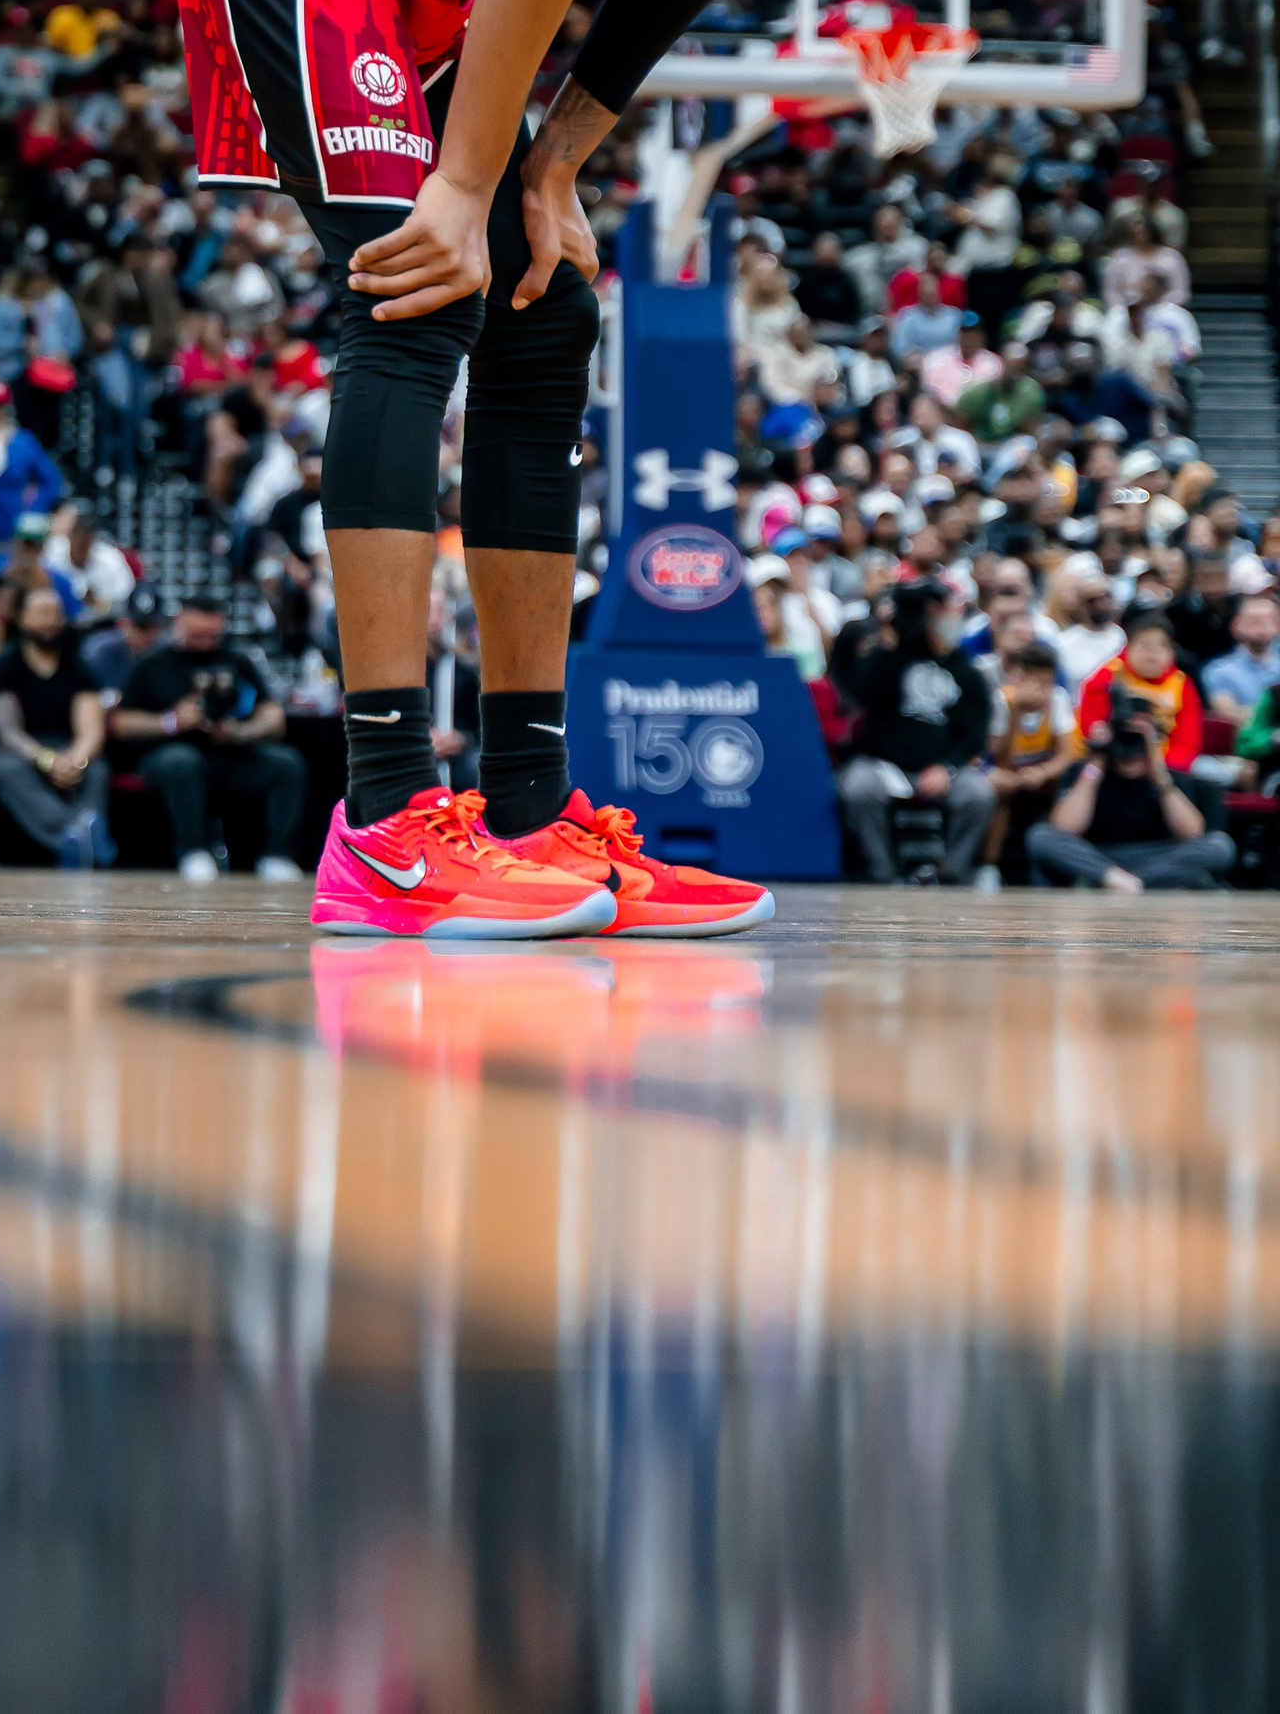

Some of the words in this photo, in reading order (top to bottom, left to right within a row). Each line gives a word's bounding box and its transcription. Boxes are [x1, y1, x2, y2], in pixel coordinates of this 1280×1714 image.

[353, 52, 373, 70] POR
[373, 51, 401, 76] AMOR
[357, 83, 371, 98] AL
[368, 87, 407, 107] BASKET
[322, 125, 433, 165] BAMESO
[604, 678, 760, 716] Prudential
